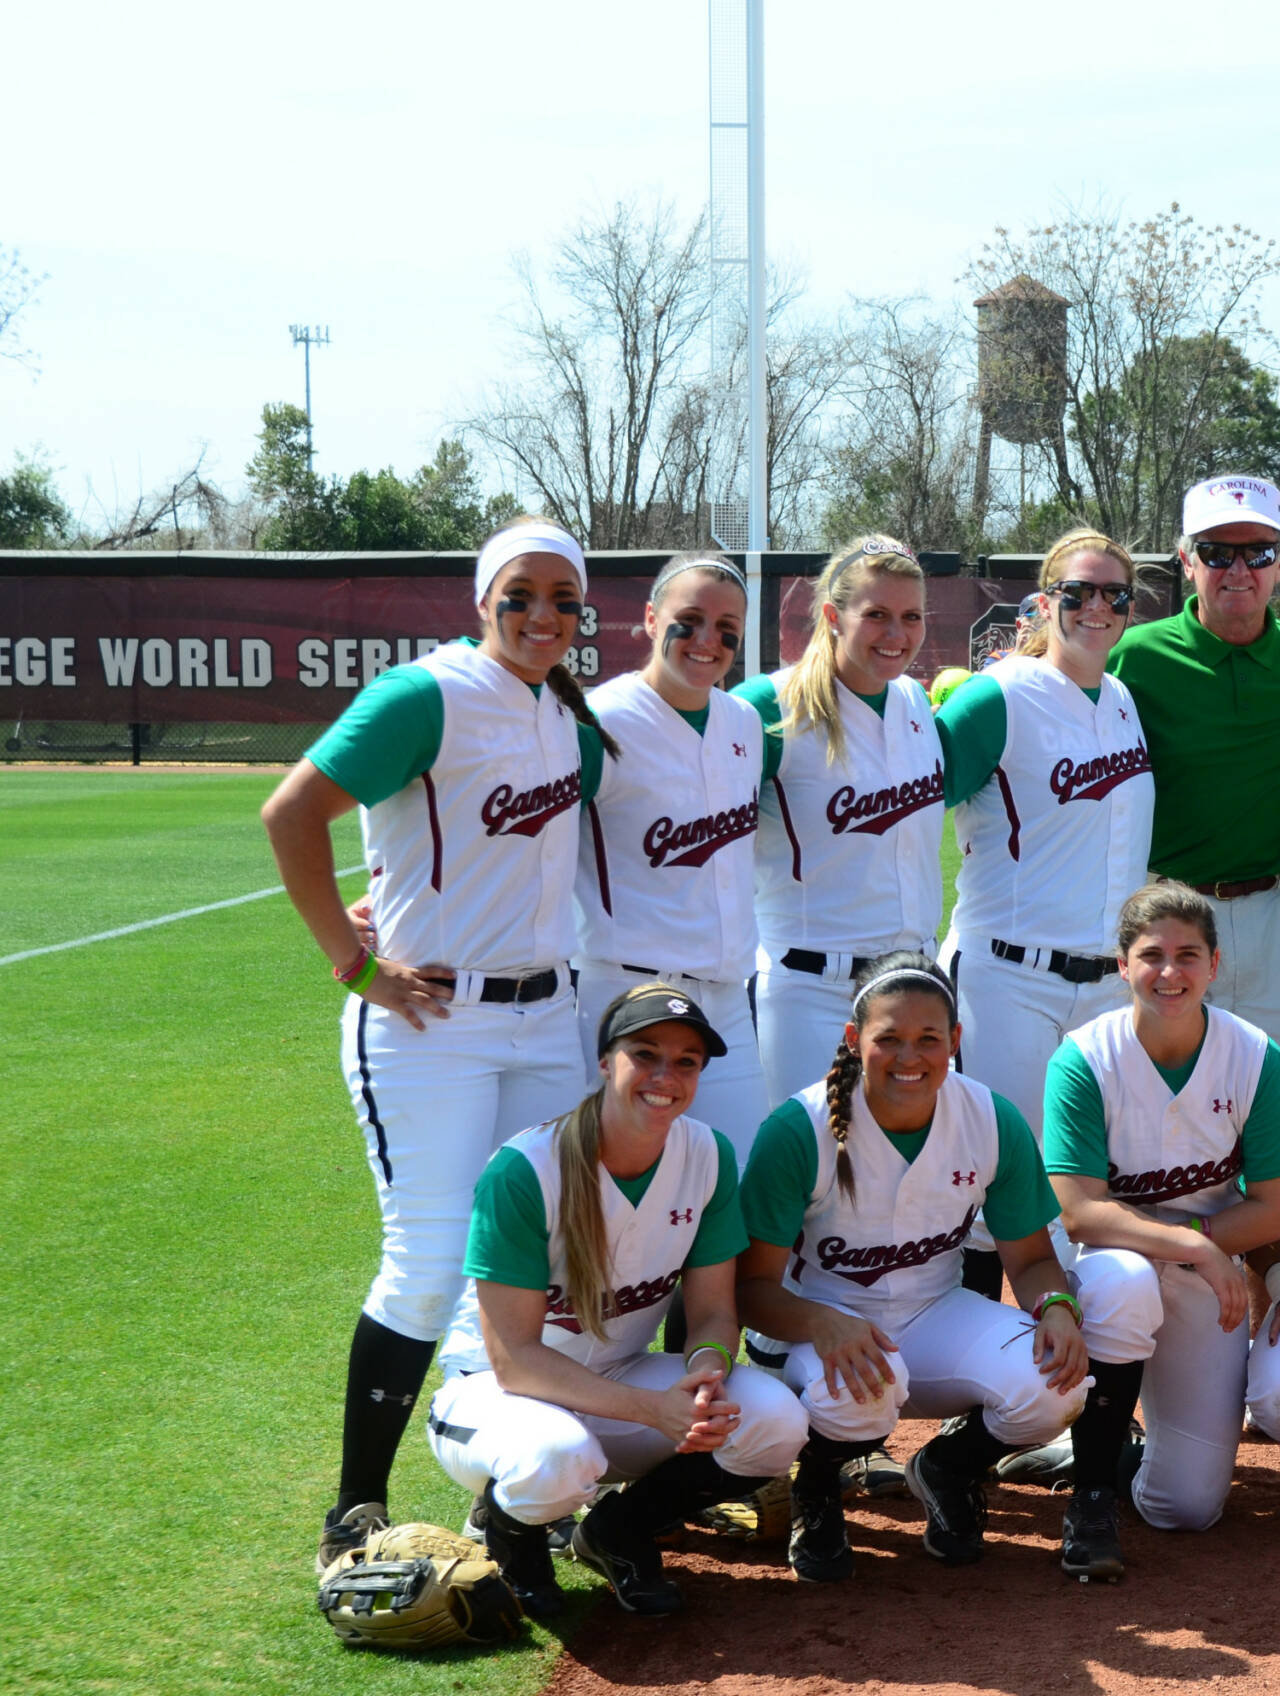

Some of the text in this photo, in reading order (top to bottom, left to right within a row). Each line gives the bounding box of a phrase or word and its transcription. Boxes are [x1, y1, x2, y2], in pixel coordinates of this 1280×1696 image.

[1209, 481, 1267, 498] CAROLINA
[99, 638, 272, 687] WORLD
[298, 638, 448, 687] SERI
